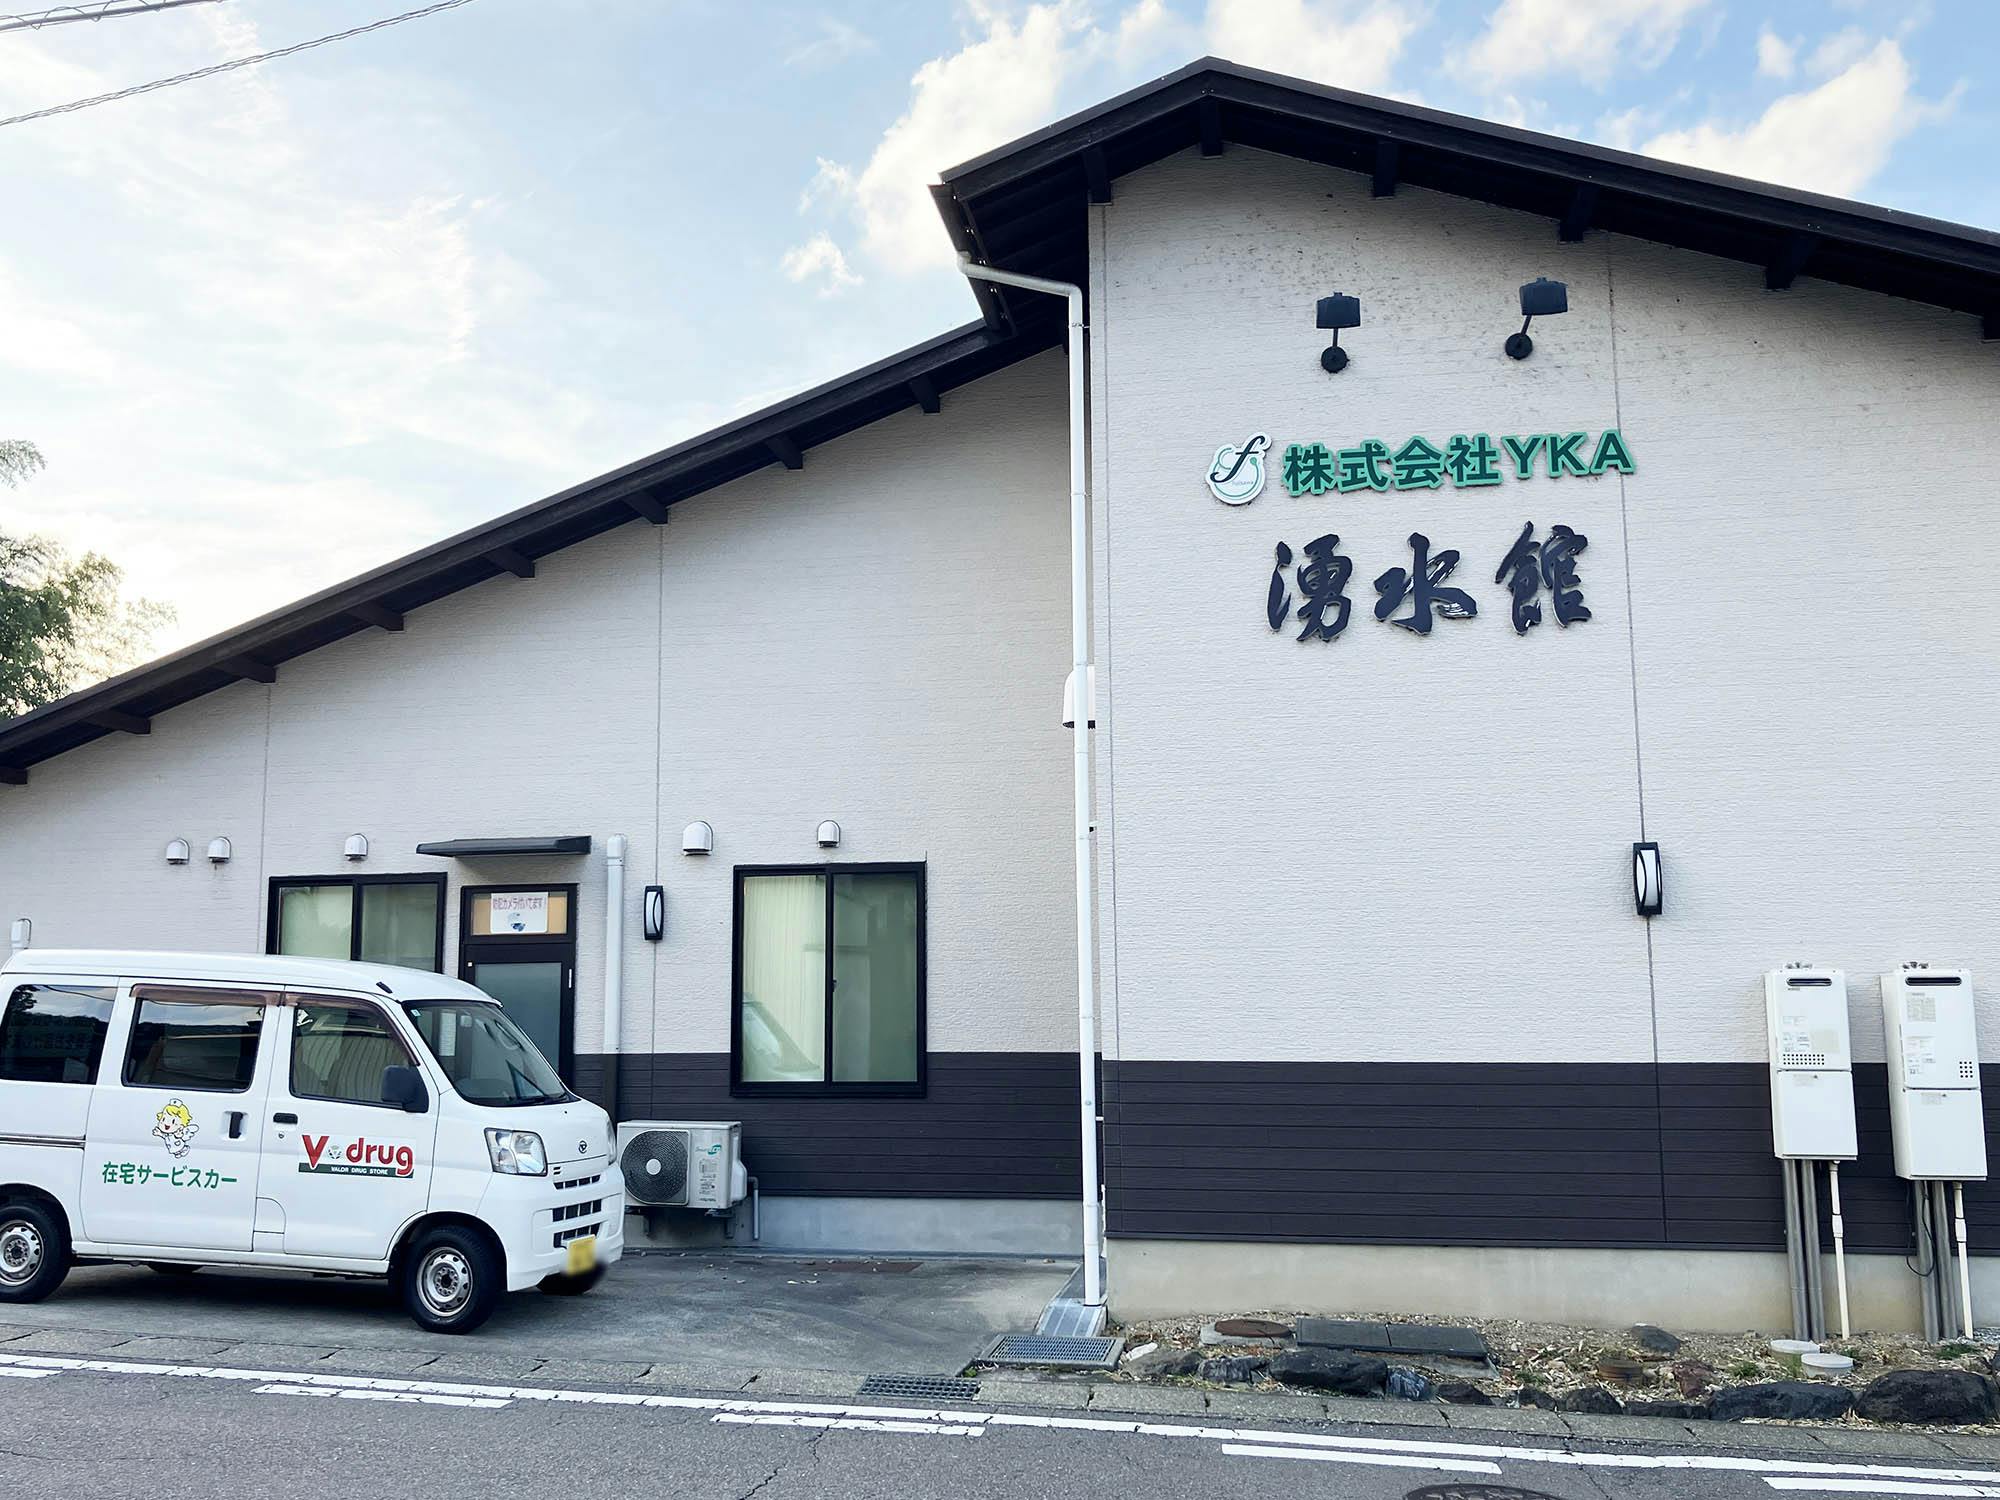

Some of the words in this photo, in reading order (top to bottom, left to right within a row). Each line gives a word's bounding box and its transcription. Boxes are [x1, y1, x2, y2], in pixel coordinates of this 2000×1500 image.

[1284, 430, 1635, 496] 株式会社YKA
[102, 1161, 238, 1189] 在宅サービスカー
[346, 1137, 413, 1176] drug
